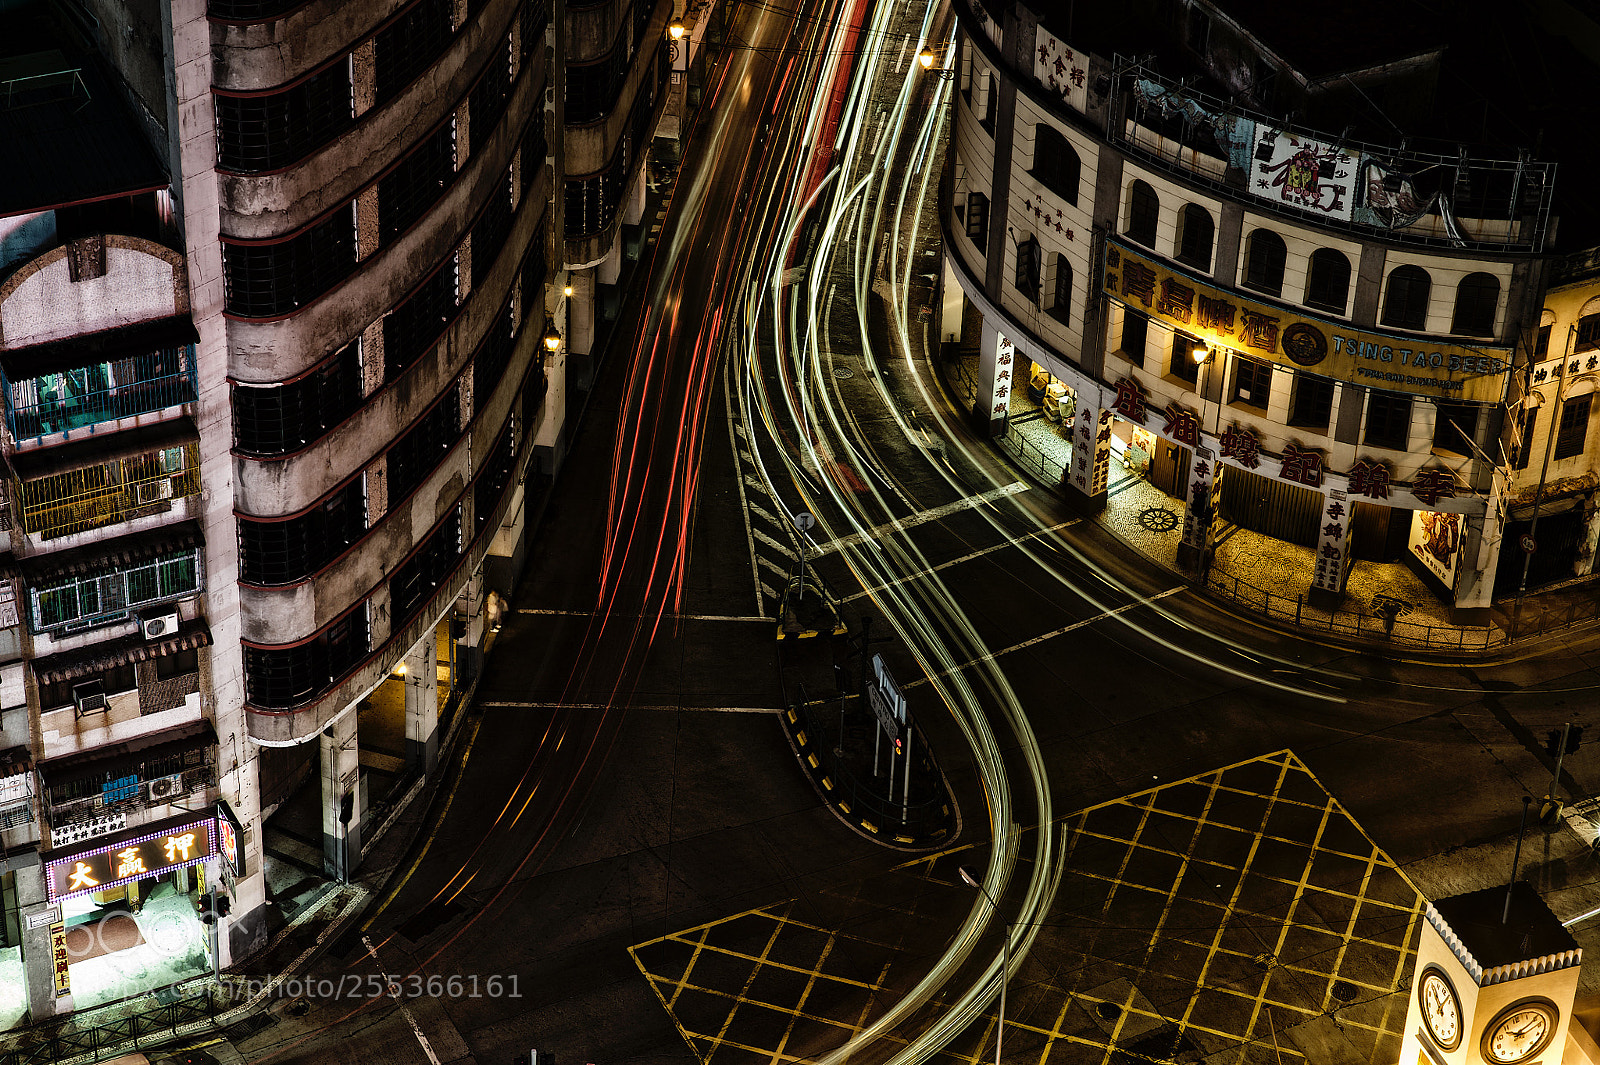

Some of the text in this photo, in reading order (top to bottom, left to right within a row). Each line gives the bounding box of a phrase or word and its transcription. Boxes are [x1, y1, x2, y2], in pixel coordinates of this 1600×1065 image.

[1121, 257, 1280, 354] 青島啤酒
[1332, 335, 1393, 363] TSING
[1400, 348, 1443, 369] TAO
[1449, 353, 1504, 375] BEER
[68, 832, 196, 891] 大贏押
